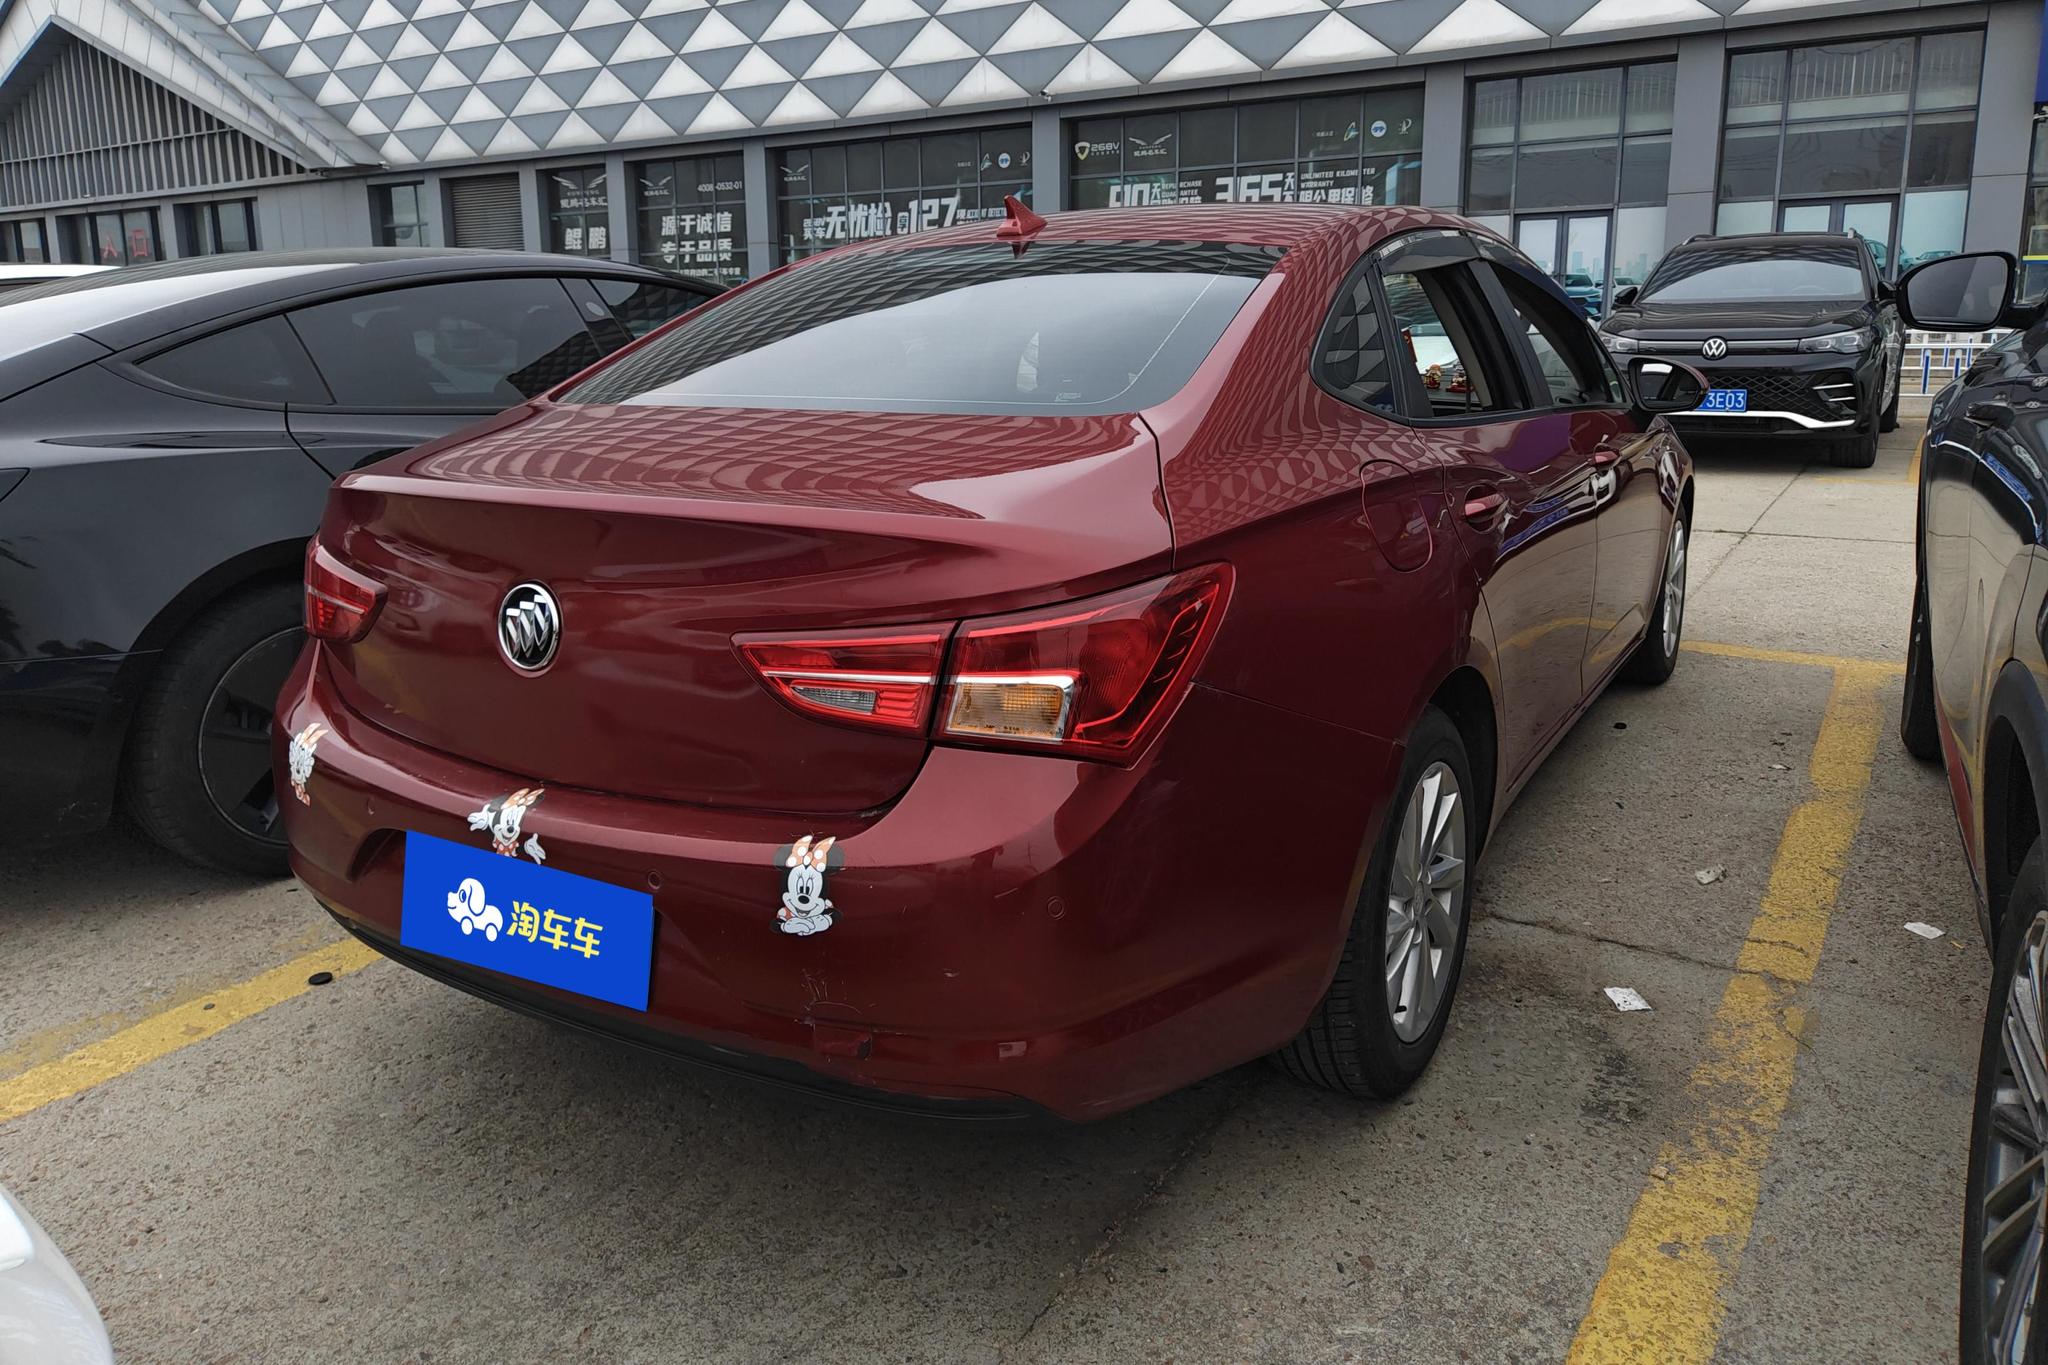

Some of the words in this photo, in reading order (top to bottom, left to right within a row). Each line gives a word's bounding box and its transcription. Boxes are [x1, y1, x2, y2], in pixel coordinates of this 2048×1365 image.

[1301, 171, 1334, 179] UNLIMITED
[1301, 180, 1334, 188] WARRANTY
[661, 211, 733, 236] 源于诚信
[564, 226, 607, 250] 鲲鹏
[661, 238, 733, 263] 专于品质
[1701, 392, 1745, 408] 3E03
